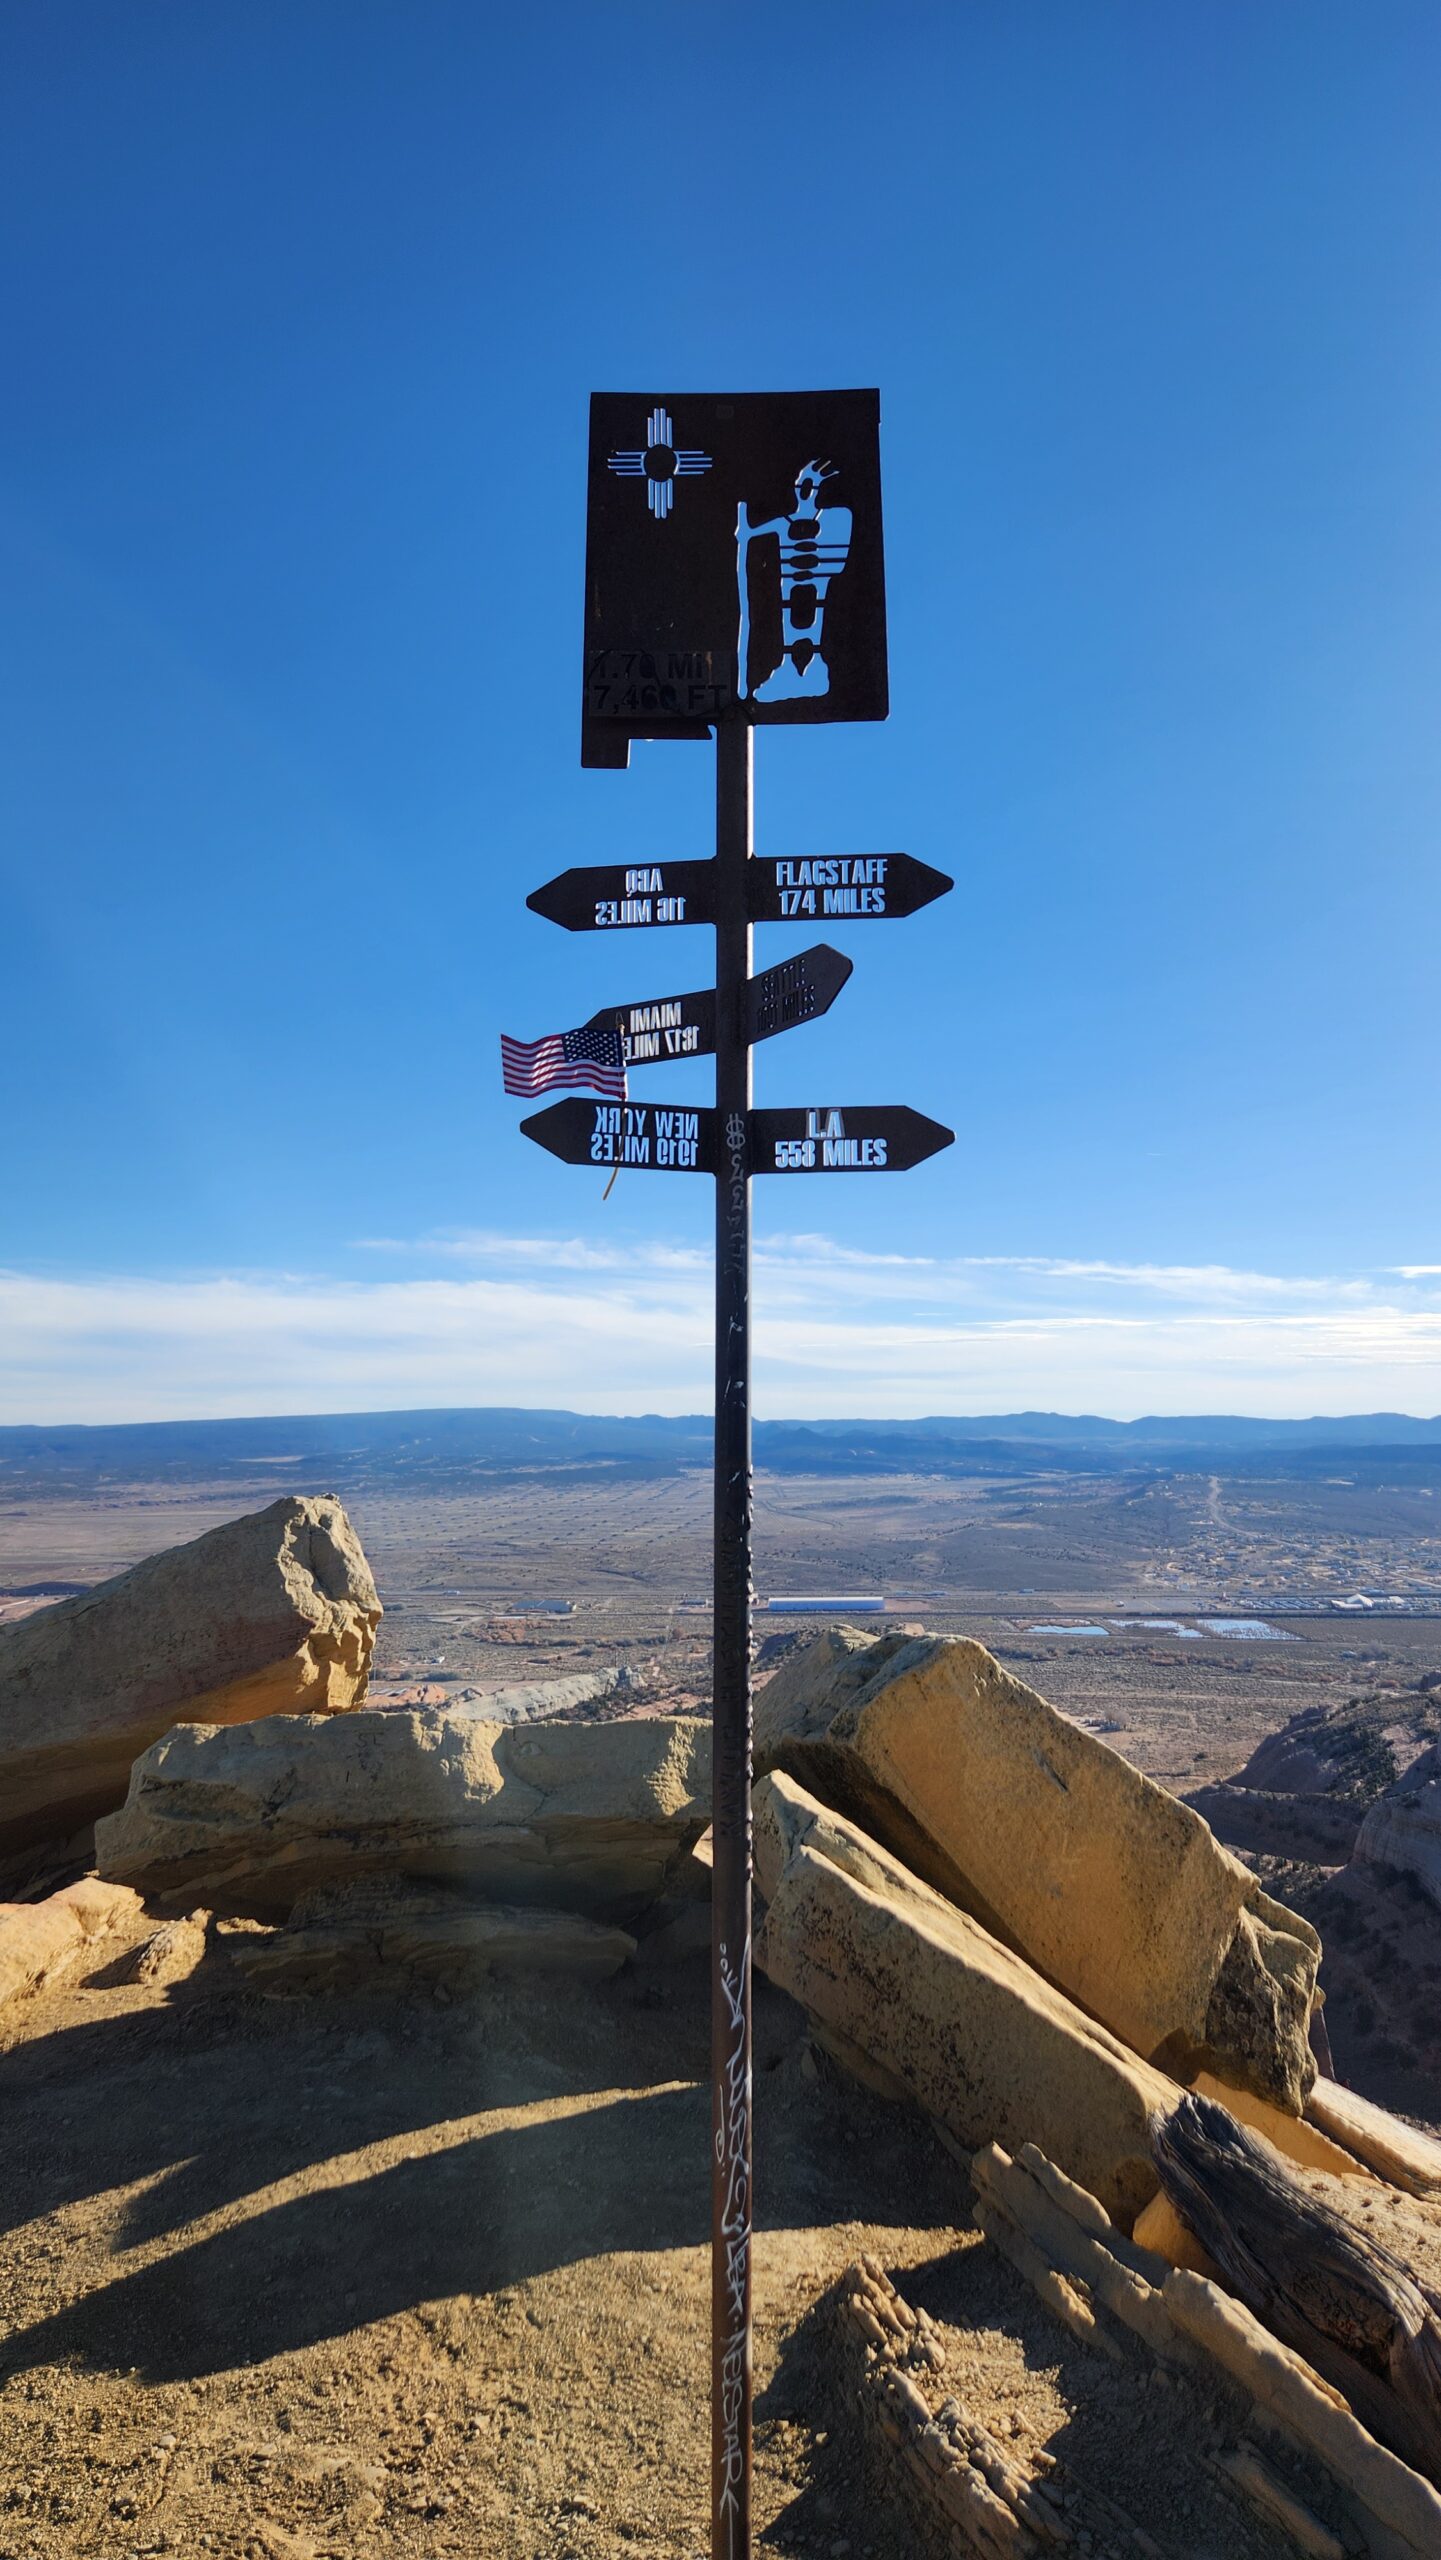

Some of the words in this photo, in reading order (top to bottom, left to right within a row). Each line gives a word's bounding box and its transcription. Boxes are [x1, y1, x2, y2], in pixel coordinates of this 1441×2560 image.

[667, 653, 703, 679] MI
[687, 685, 727, 711] FT
[775, 859, 888, 887] FLAGSTAFF
[778, 889, 817, 916] 174
[823, 887, 886, 915] MILES
[774, 1140, 817, 1169] 558
[822, 1138, 888, 1167] MILES
